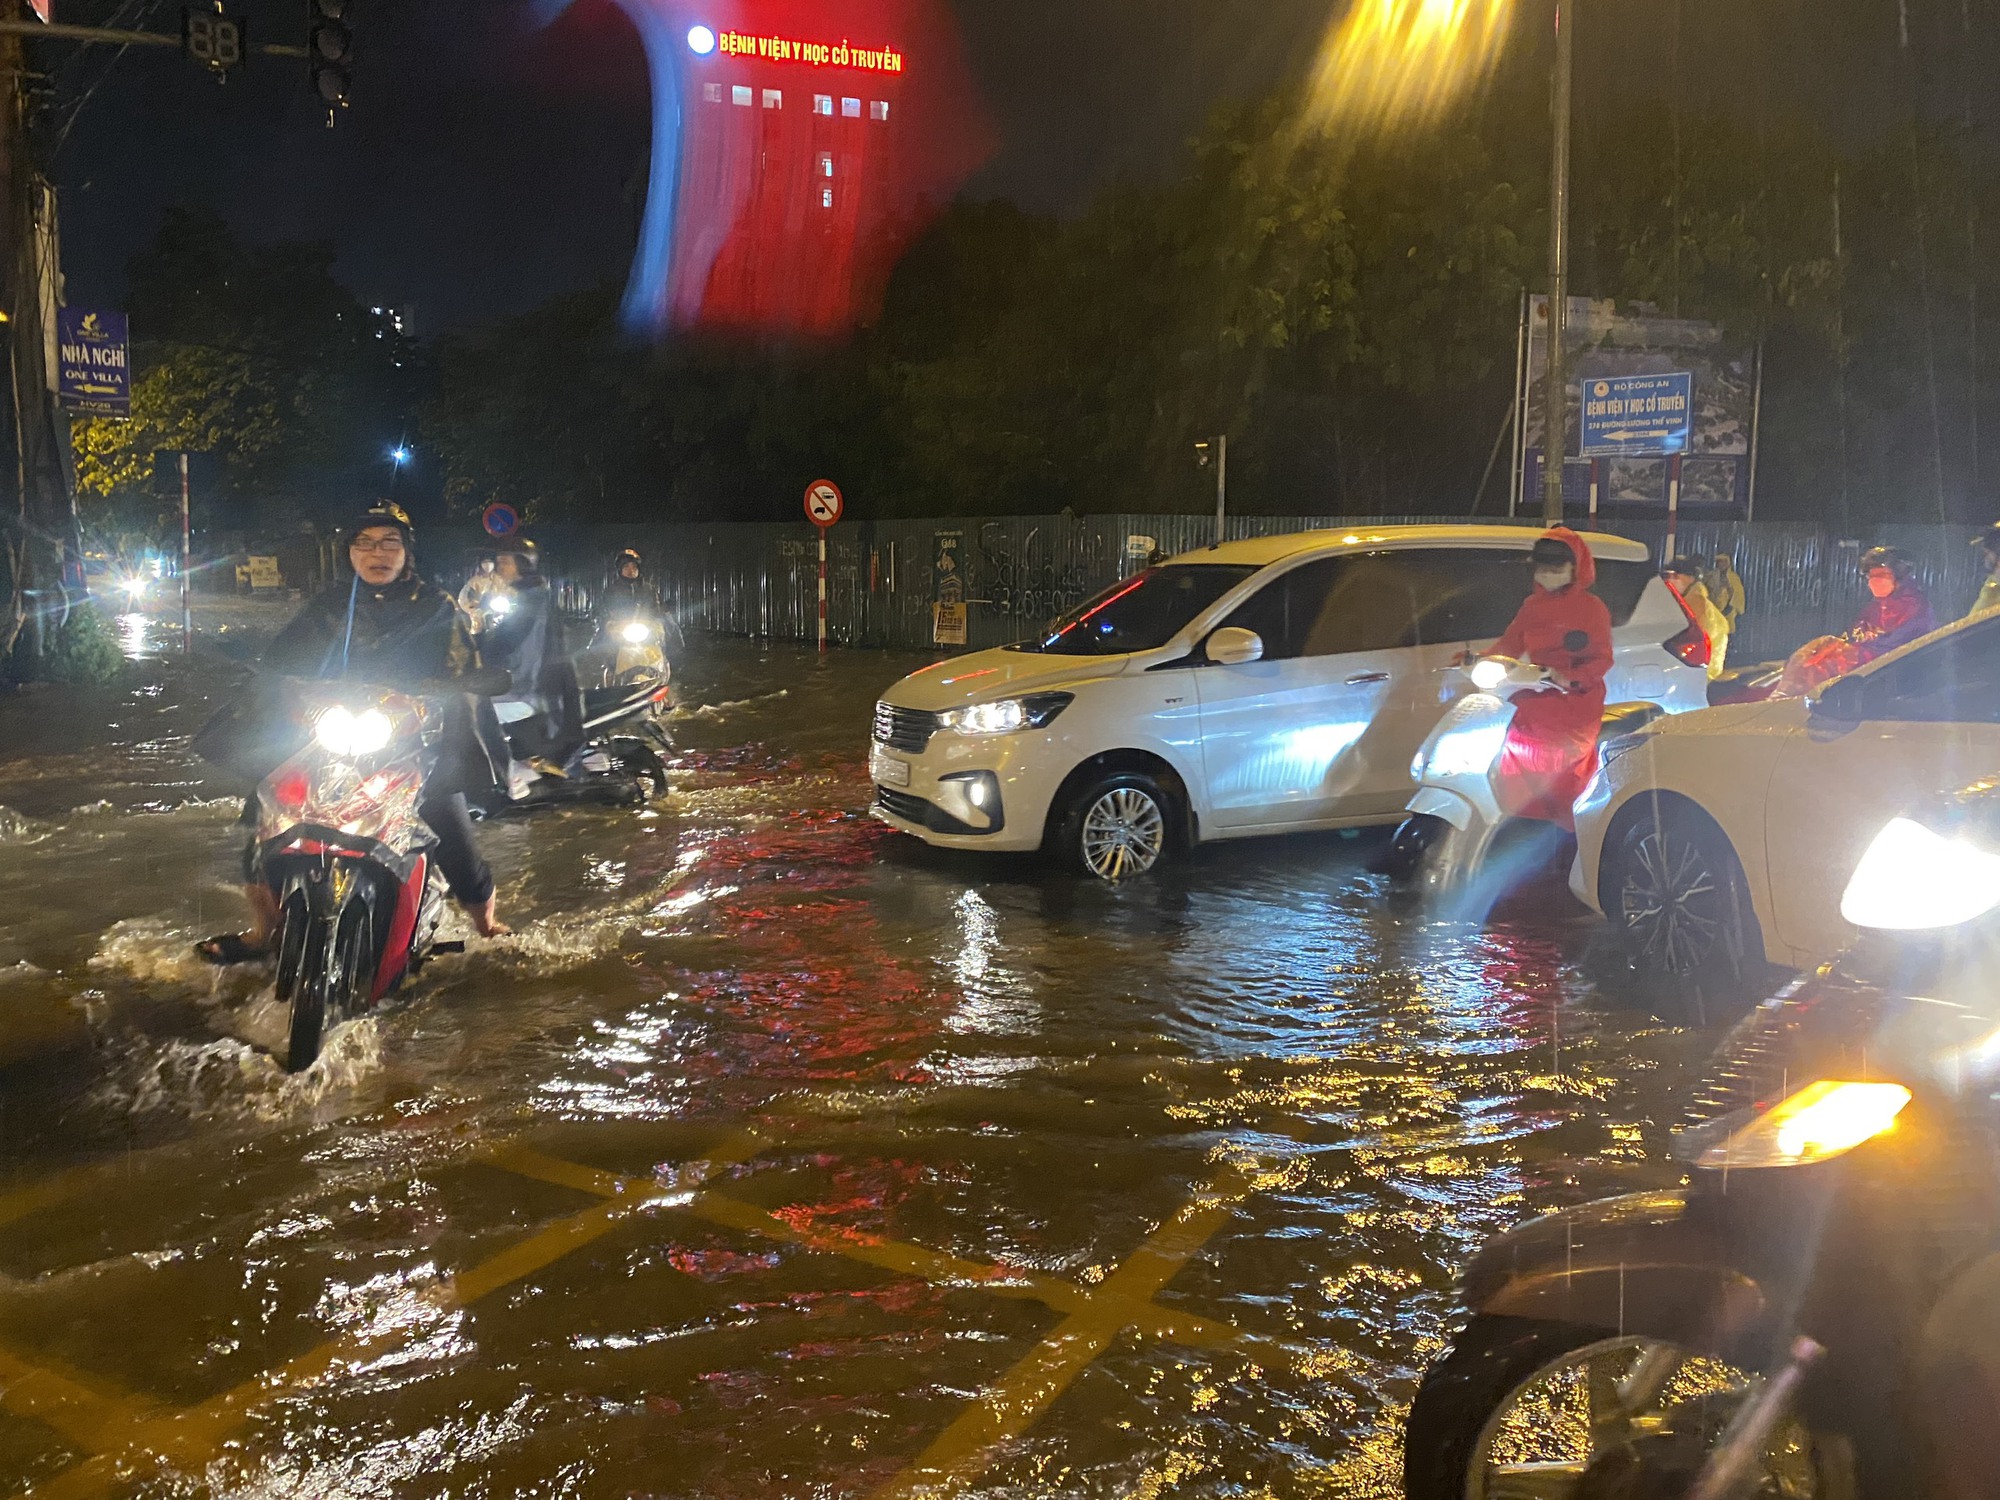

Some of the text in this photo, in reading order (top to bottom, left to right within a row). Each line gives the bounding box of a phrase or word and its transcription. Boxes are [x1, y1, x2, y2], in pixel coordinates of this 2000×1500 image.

[719, 30, 901, 71] BỆNH VIỆN Y HỌC CỔ TRUYỀN
[62, 343, 125, 368] NHÀ NGHỈ
[65, 369, 122, 384] ONE VILLA
[1587, 399, 1606, 418] BỆNH
[1607, 397, 1623, 417] VIỆN
[1625, 400, 1629, 413] Y
[1630, 398, 1645, 416] HỌC
